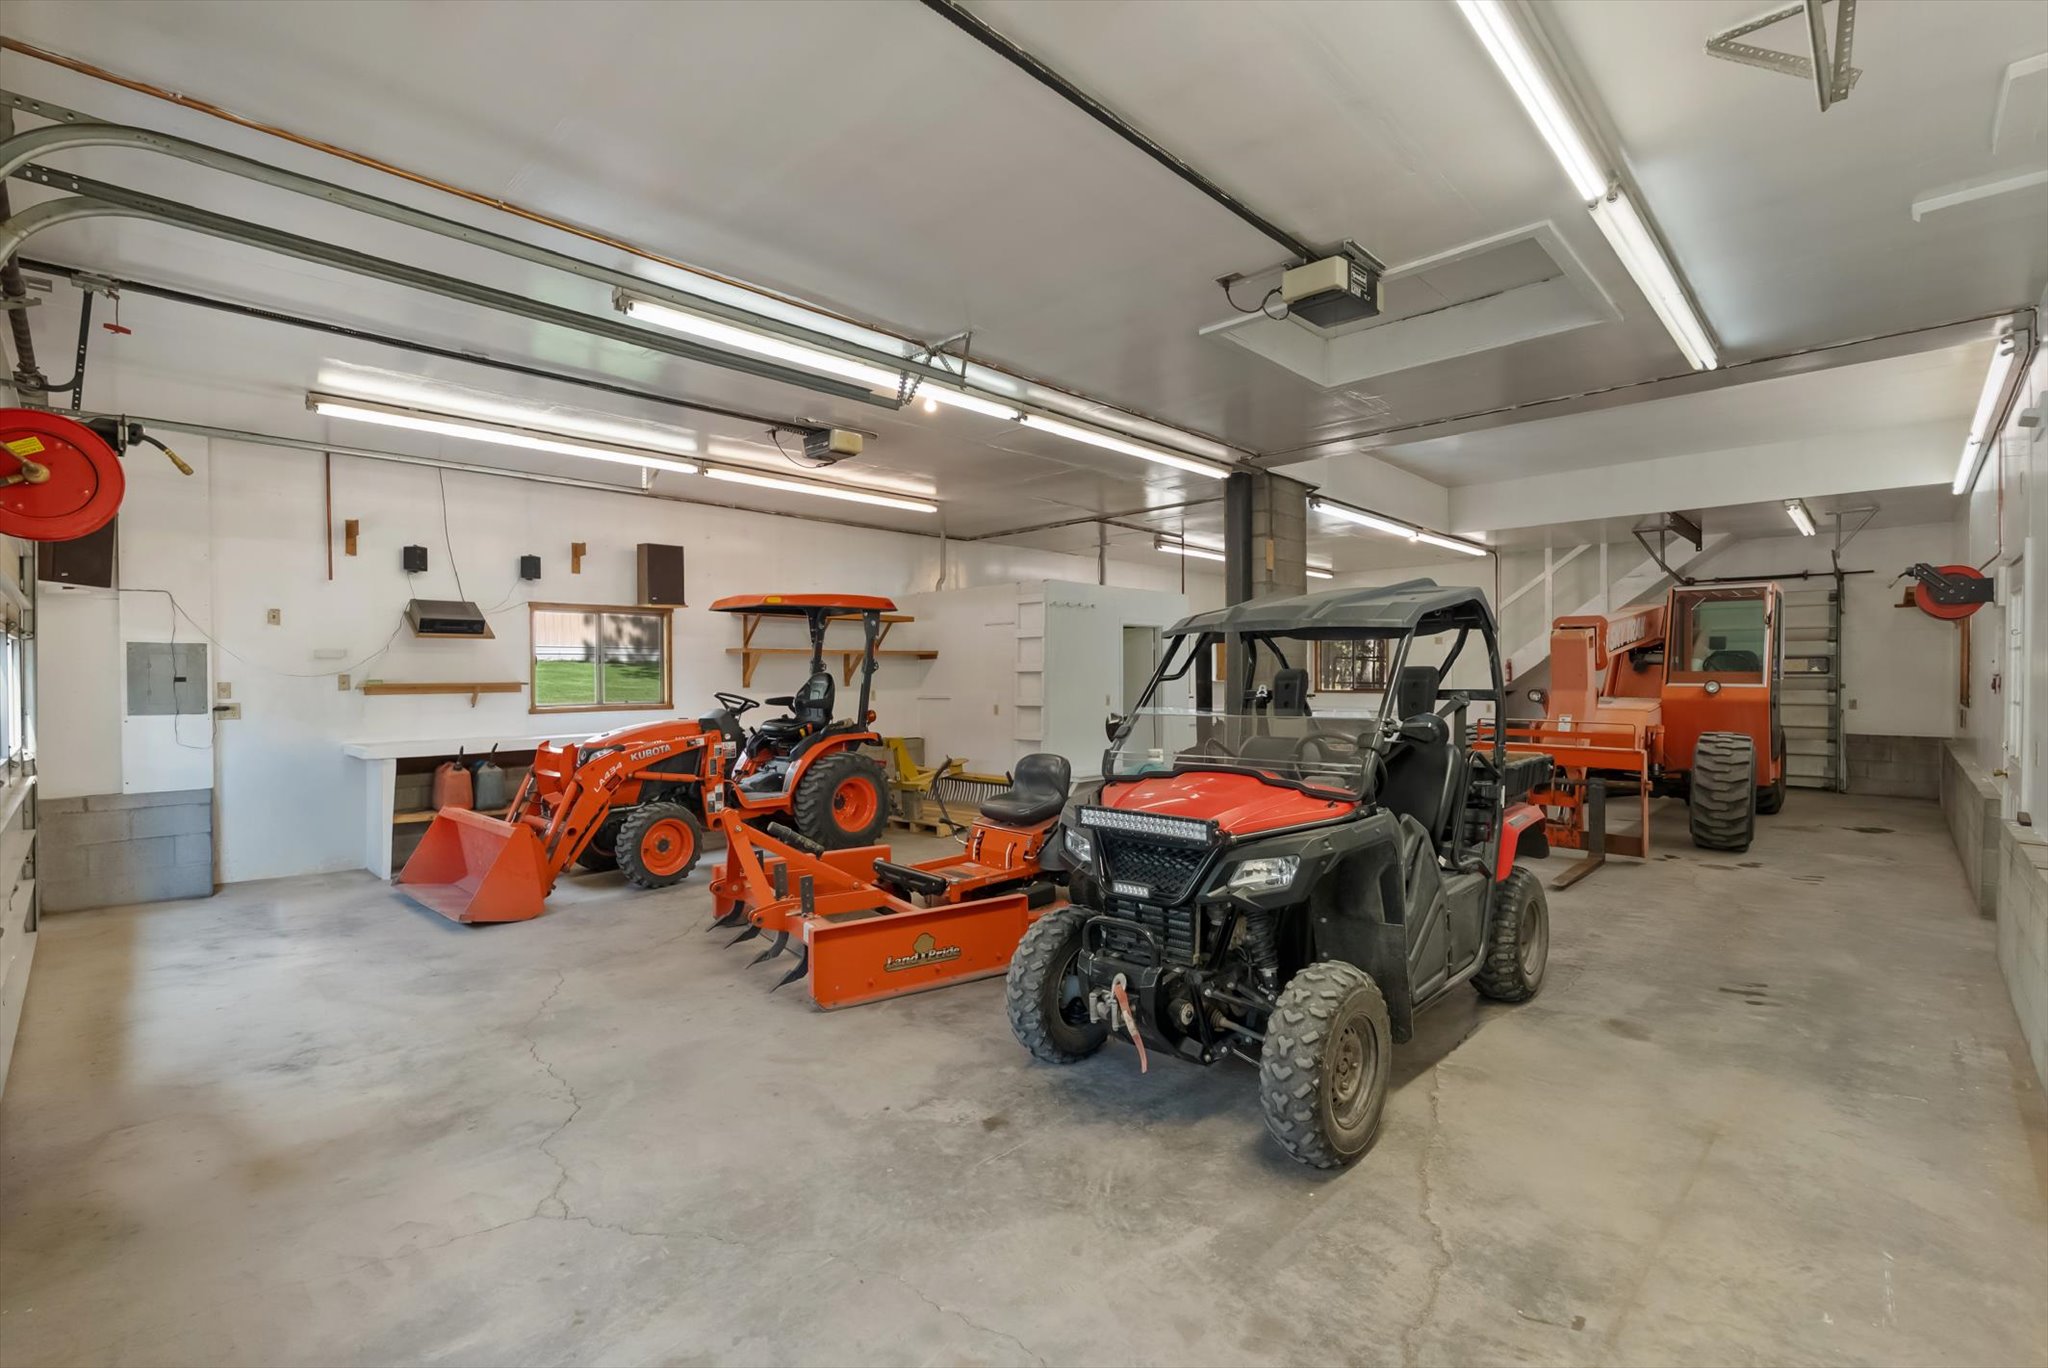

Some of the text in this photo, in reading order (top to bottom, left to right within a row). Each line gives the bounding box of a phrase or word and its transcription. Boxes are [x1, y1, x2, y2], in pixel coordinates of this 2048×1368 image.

[630, 744, 671, 761] KUBOTA
[594, 762, 623, 793] LA434
[887, 946, 960, 966] Land Pride
